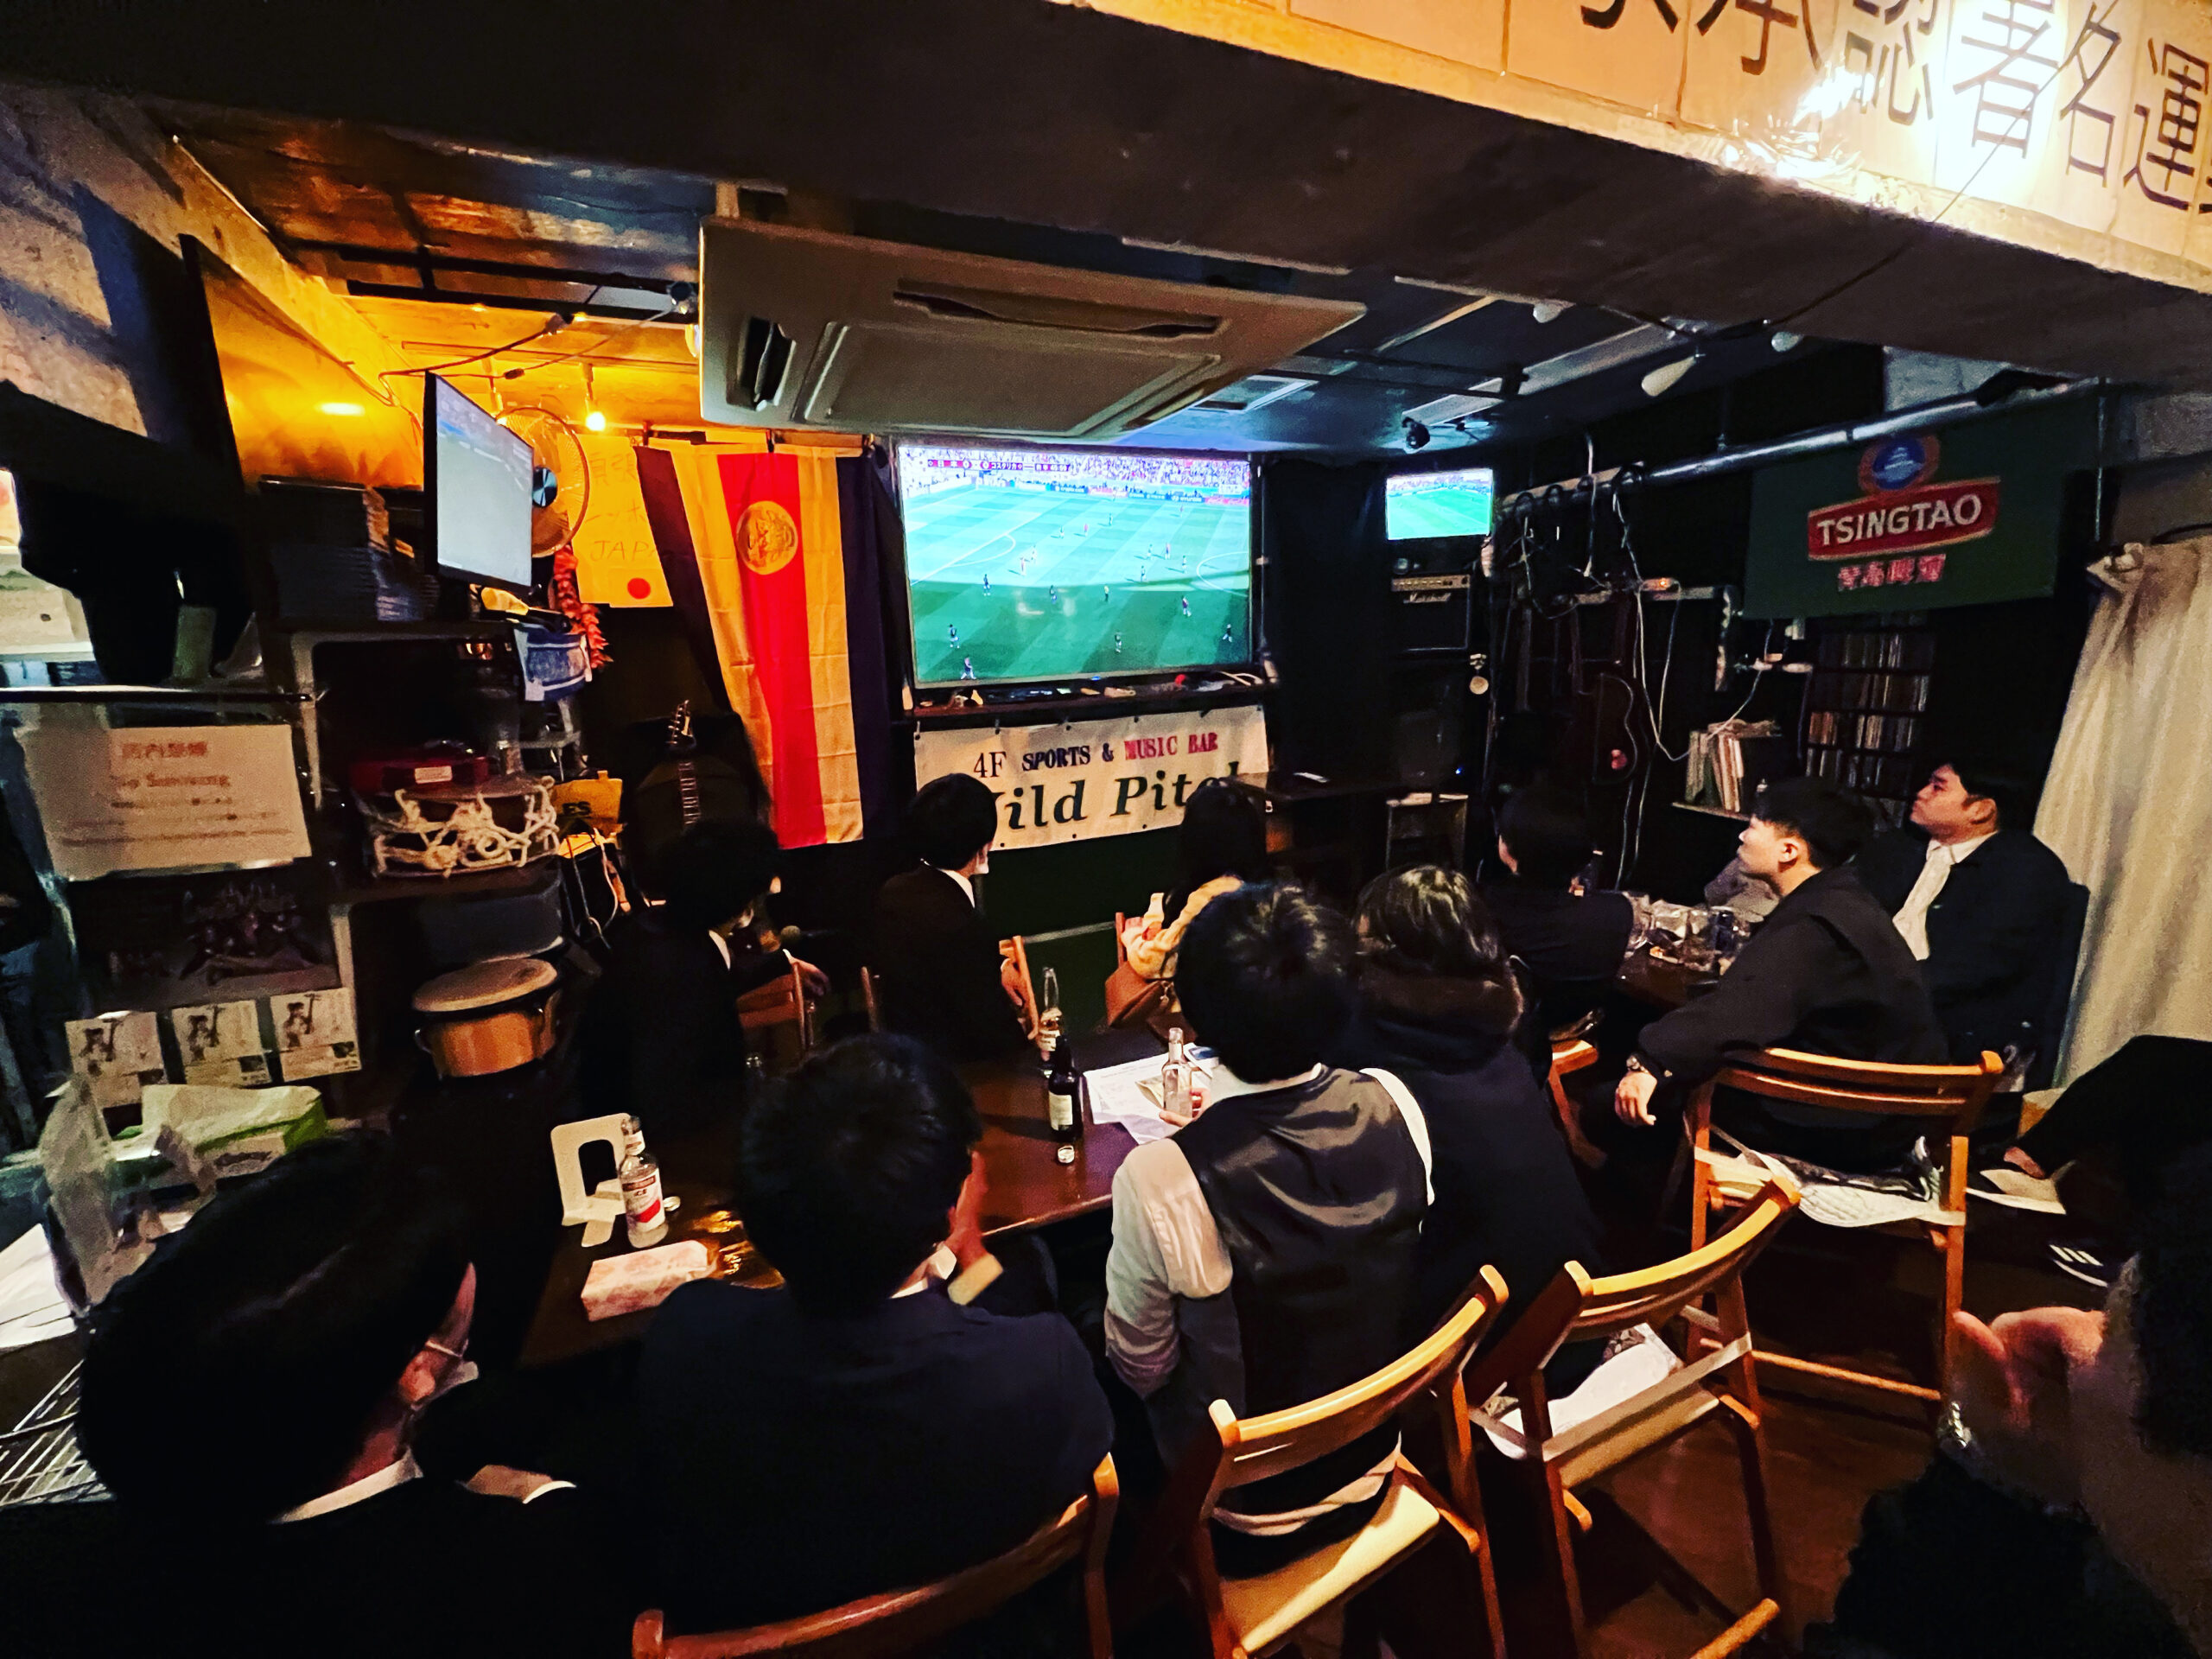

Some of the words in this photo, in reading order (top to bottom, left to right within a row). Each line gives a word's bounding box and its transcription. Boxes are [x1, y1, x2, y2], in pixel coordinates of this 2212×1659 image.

[1817, 493, 1982, 546] TSINGTAO
[973, 751, 1007, 779] 4F
[1021, 745, 1091, 772] SPORTS
[1101, 742, 1115, 763] &
[1123, 734, 1178, 761] MUSIC
[1187, 732, 1219, 754] BAR
[992, 779, 1088, 831] ild
